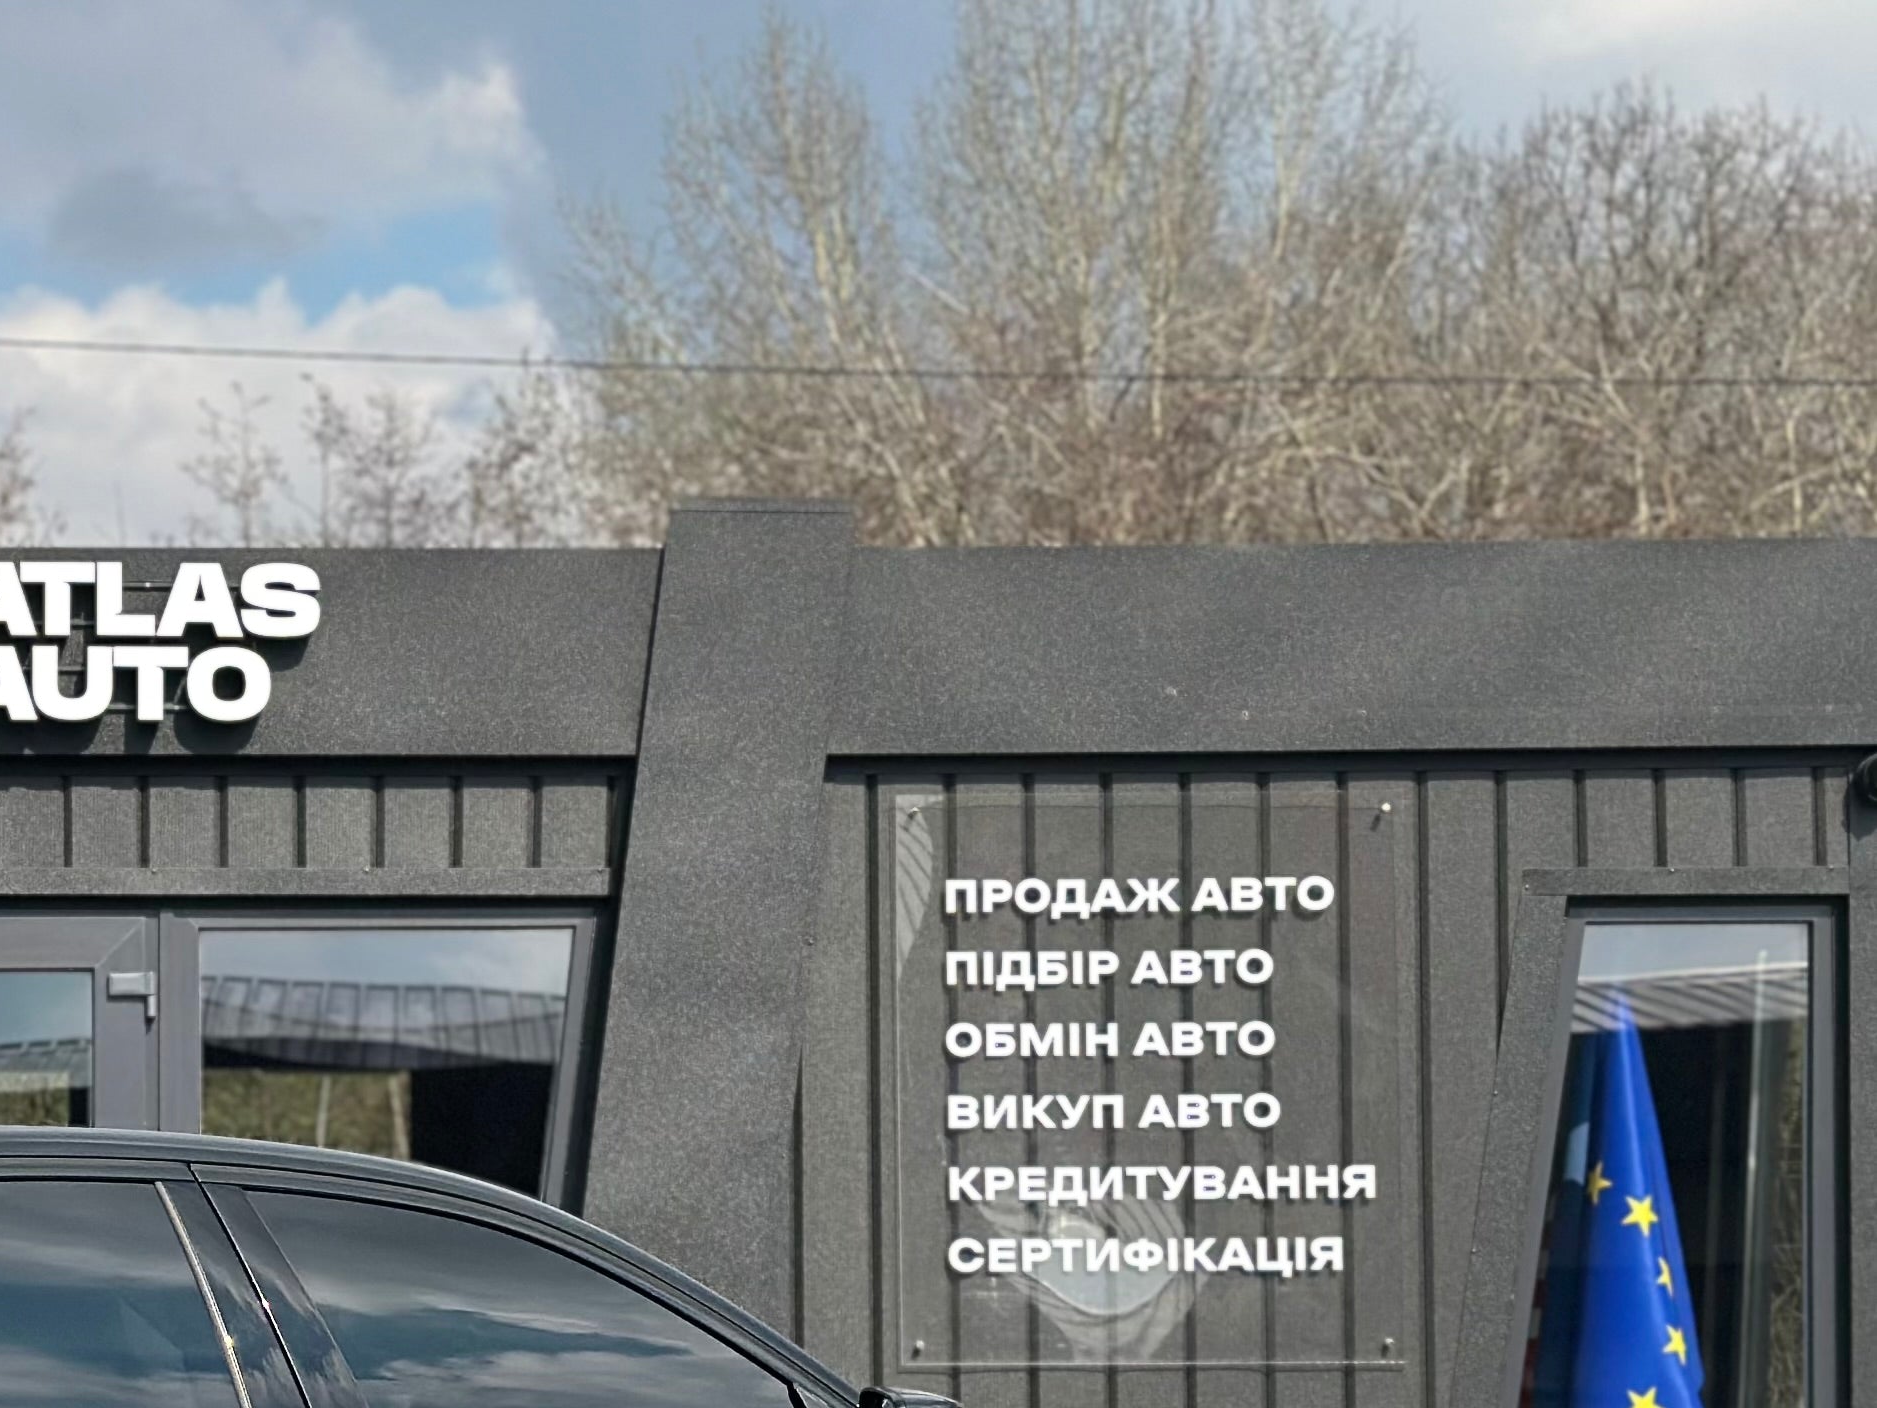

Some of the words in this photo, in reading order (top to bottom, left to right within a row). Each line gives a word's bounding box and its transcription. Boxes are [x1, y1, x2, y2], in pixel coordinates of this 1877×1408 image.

[945, 877, 1181, 920] ПРОДАЖ
[1191, 875, 1335, 912] АВТО
[945, 950, 1120, 992] ПІДБІР
[1130, 948, 1274, 985] АВТО
[945, 1022, 1119, 1058] ОБМІН
[1132, 1020, 1276, 1057] АВТО
[947, 1094, 1124, 1130] ВИКУП
[1137, 1092, 1281, 1129] АВТО
[948, 1164, 1376, 1208] КРЕДИТУВАННЯ
[948, 1236, 1344, 1279] СЕРТИФІКАЦІЯ
